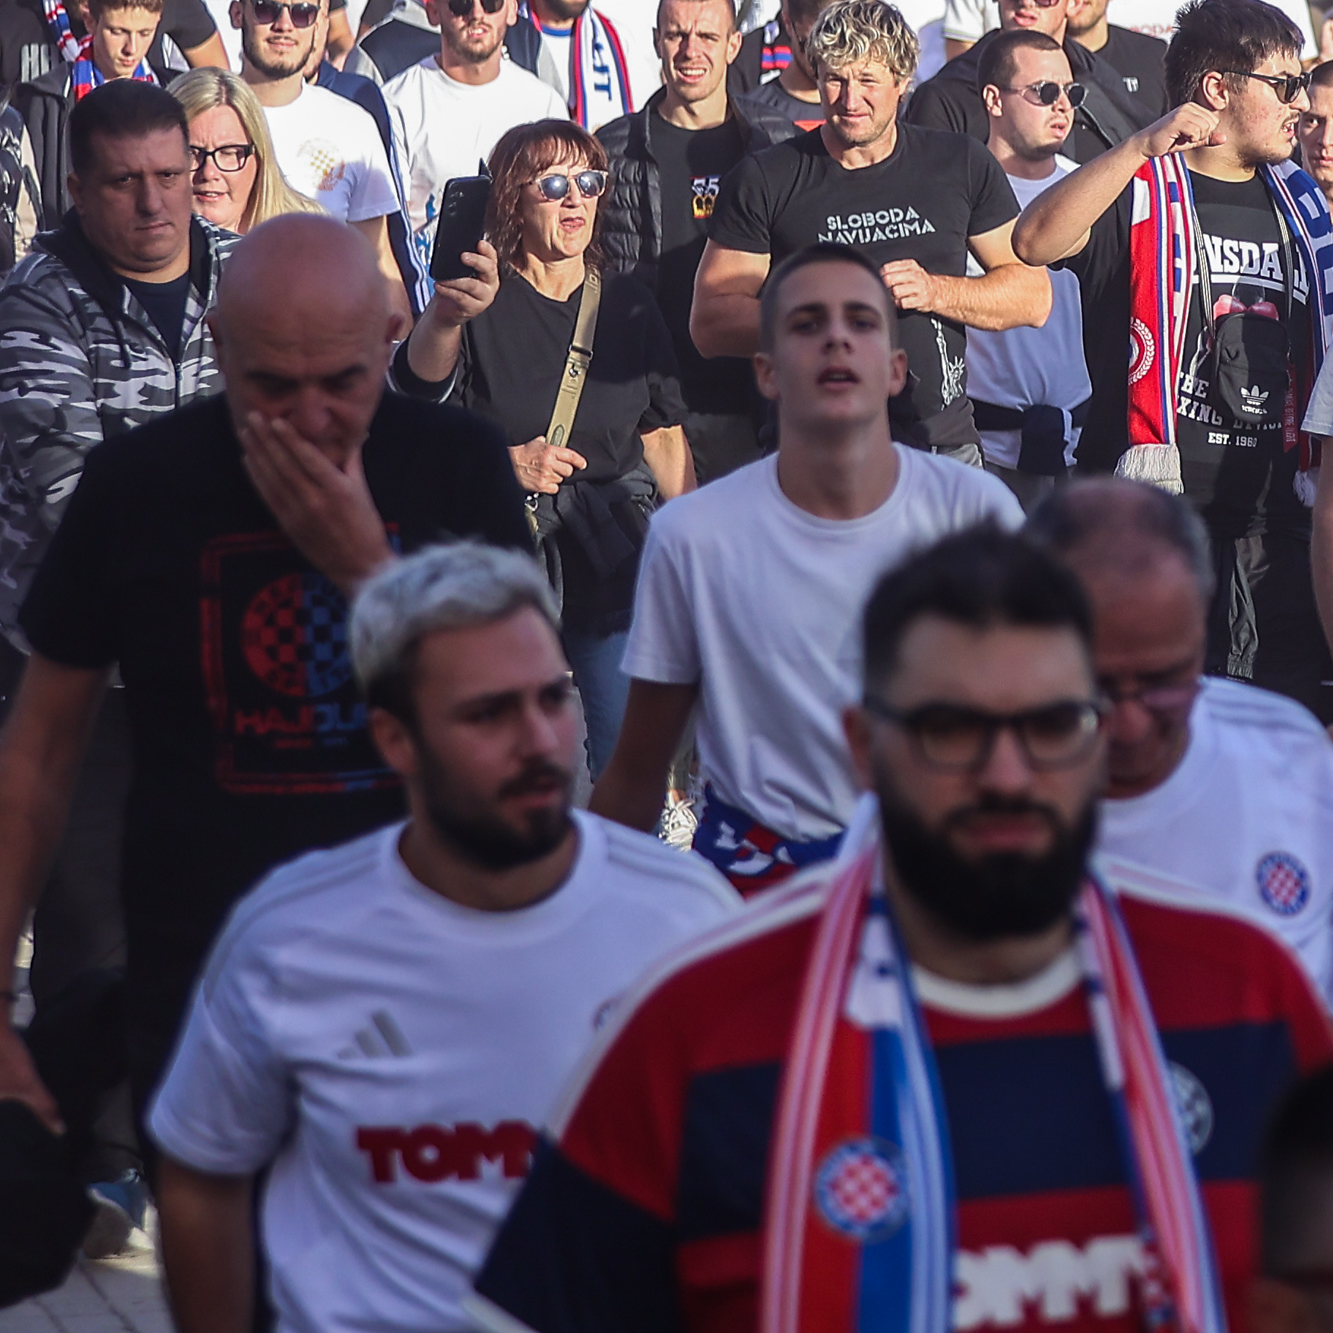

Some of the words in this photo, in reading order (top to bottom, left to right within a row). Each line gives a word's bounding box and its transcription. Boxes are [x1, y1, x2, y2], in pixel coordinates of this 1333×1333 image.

[827, 206, 920, 230] SLOBODA
[1208, 432, 1232, 446] EST.
[1235, 435, 1258, 448] 1960
[234, 702, 368, 736] HAJDU
